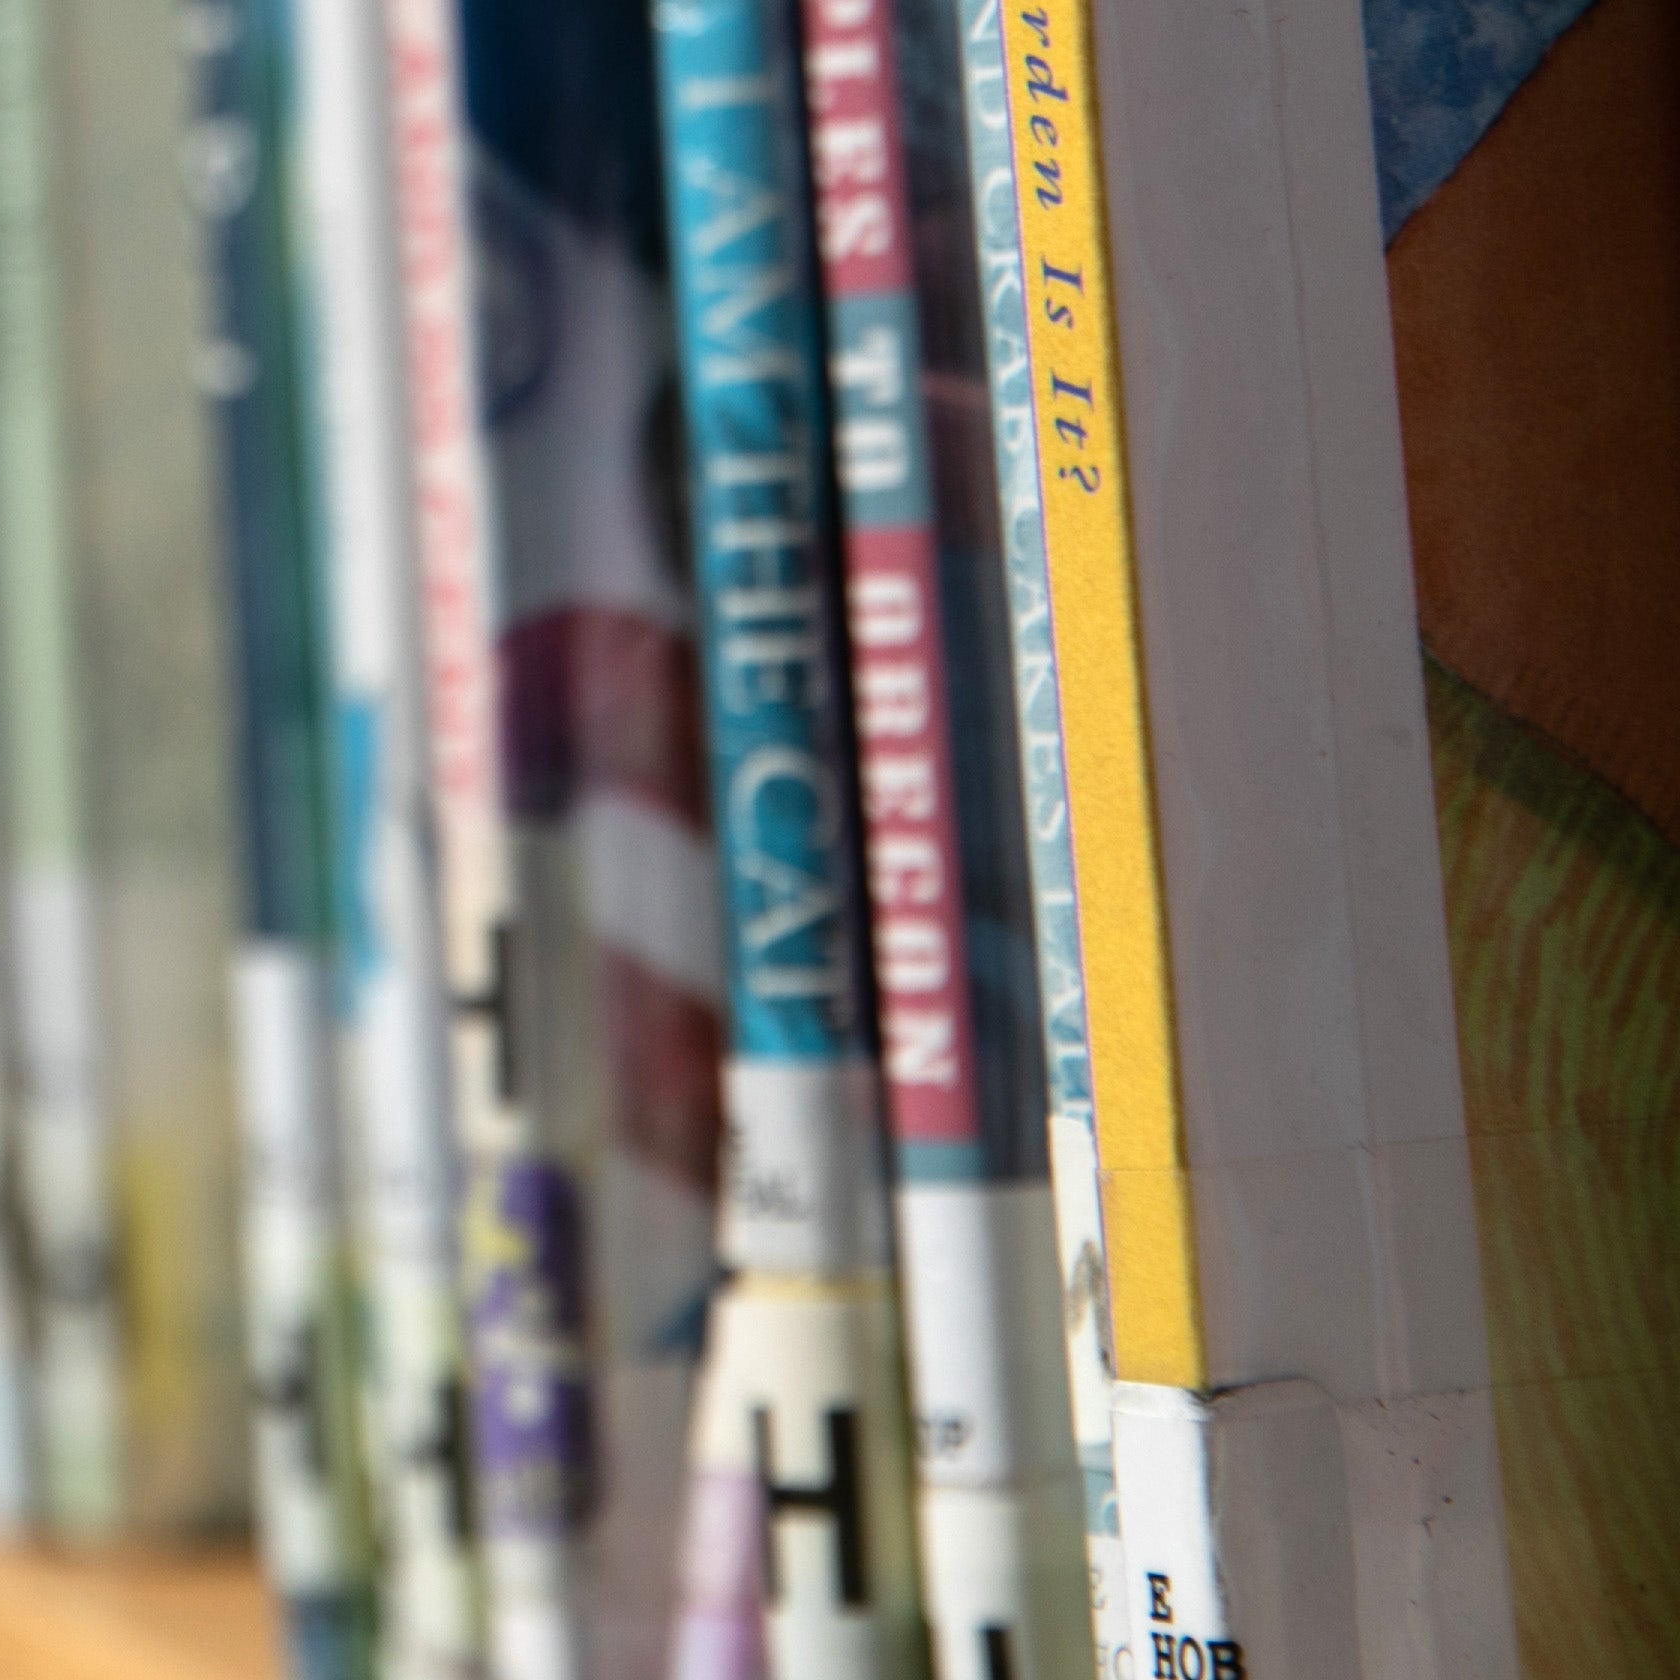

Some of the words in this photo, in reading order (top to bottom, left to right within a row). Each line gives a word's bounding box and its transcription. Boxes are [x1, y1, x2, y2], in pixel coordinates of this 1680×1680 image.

[687, 152, 800, 386] AM
[1040, 256, 1086, 330] Is
[828, 326, 908, 490] TO
[1050, 368, 1102, 494] It?
[708, 420, 822, 720] THE
[728, 744, 852, 1032] CAT
[844, 572, 958, 1090] OREGON
[1146, 1572, 1173, 1624] E
[1149, 1631, 1247, 1680] HOB
